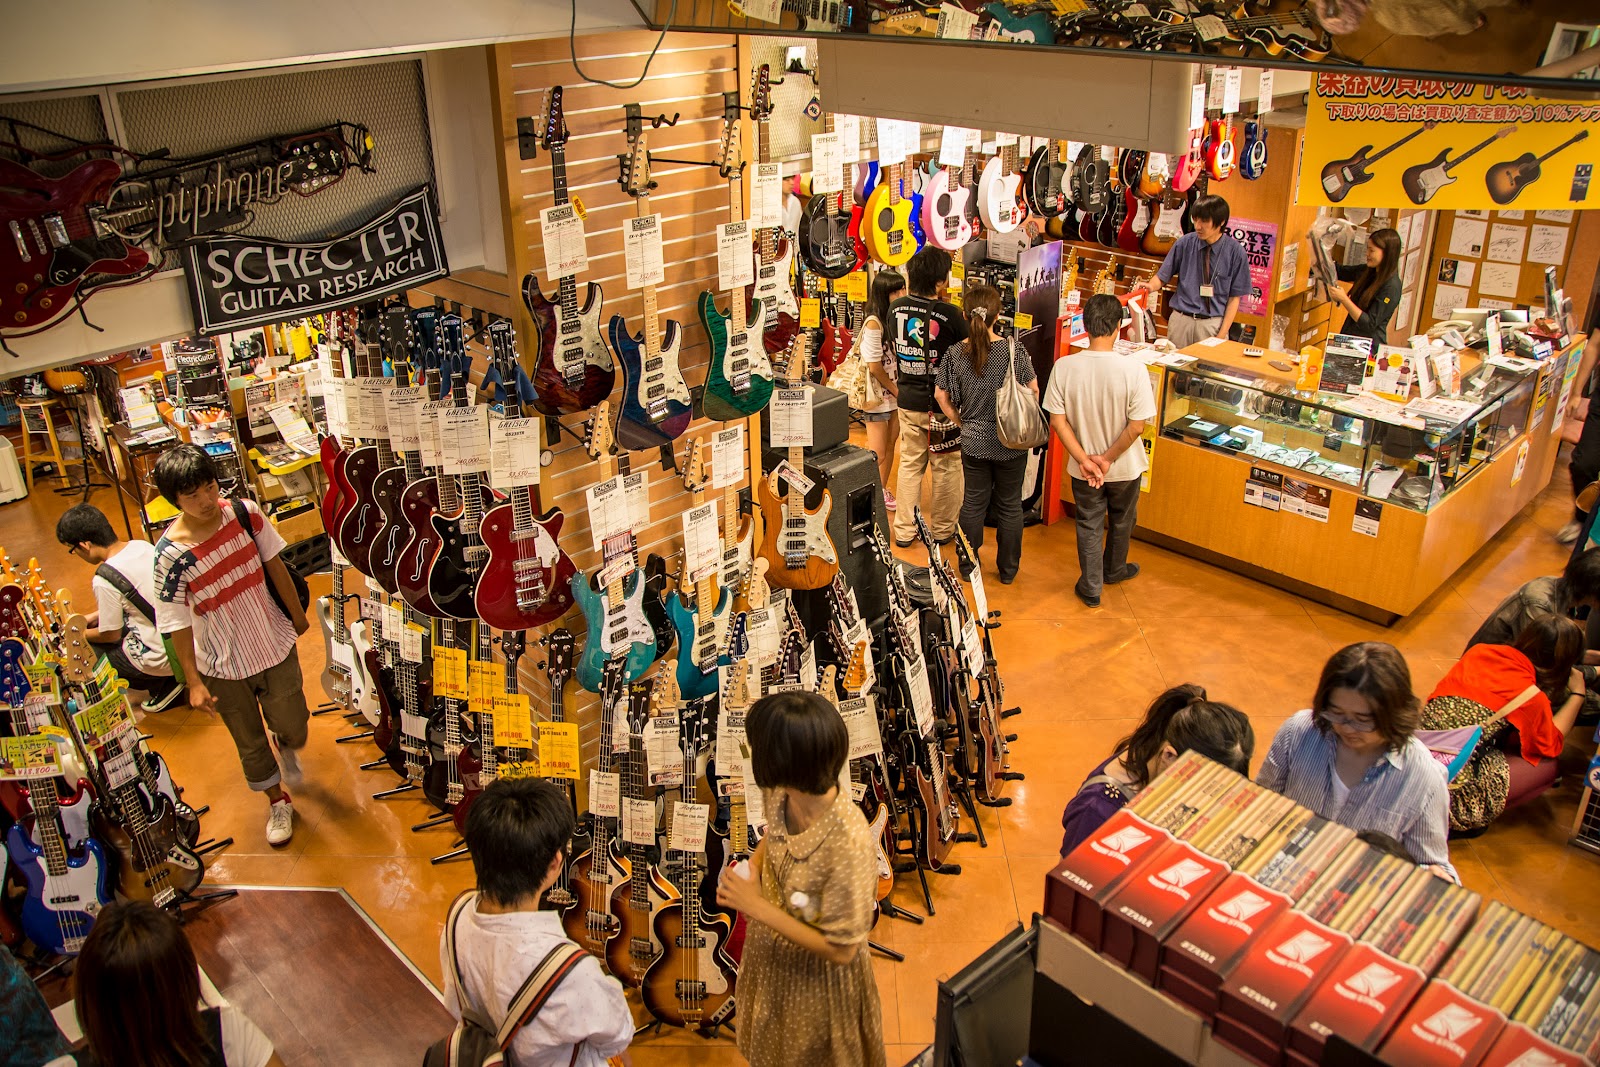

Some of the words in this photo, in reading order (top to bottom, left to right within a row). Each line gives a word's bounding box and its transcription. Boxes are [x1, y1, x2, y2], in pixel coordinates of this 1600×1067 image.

[98, 161, 293, 245] Epiphone
[207, 211, 425, 289] SCHECTER
[220, 283, 313, 314] GUITAR
[319, 248, 425, 299] RESEARCH
[895, 312, 909, 347] I
[896, 343, 938, 358] LONGBOD
[390, 387, 420, 396] GRETSCH
[423, 400, 453, 410] GRETSCH
[446, 407, 478, 416] GRETSCH
[498, 419, 531, 429] GRETSCH
